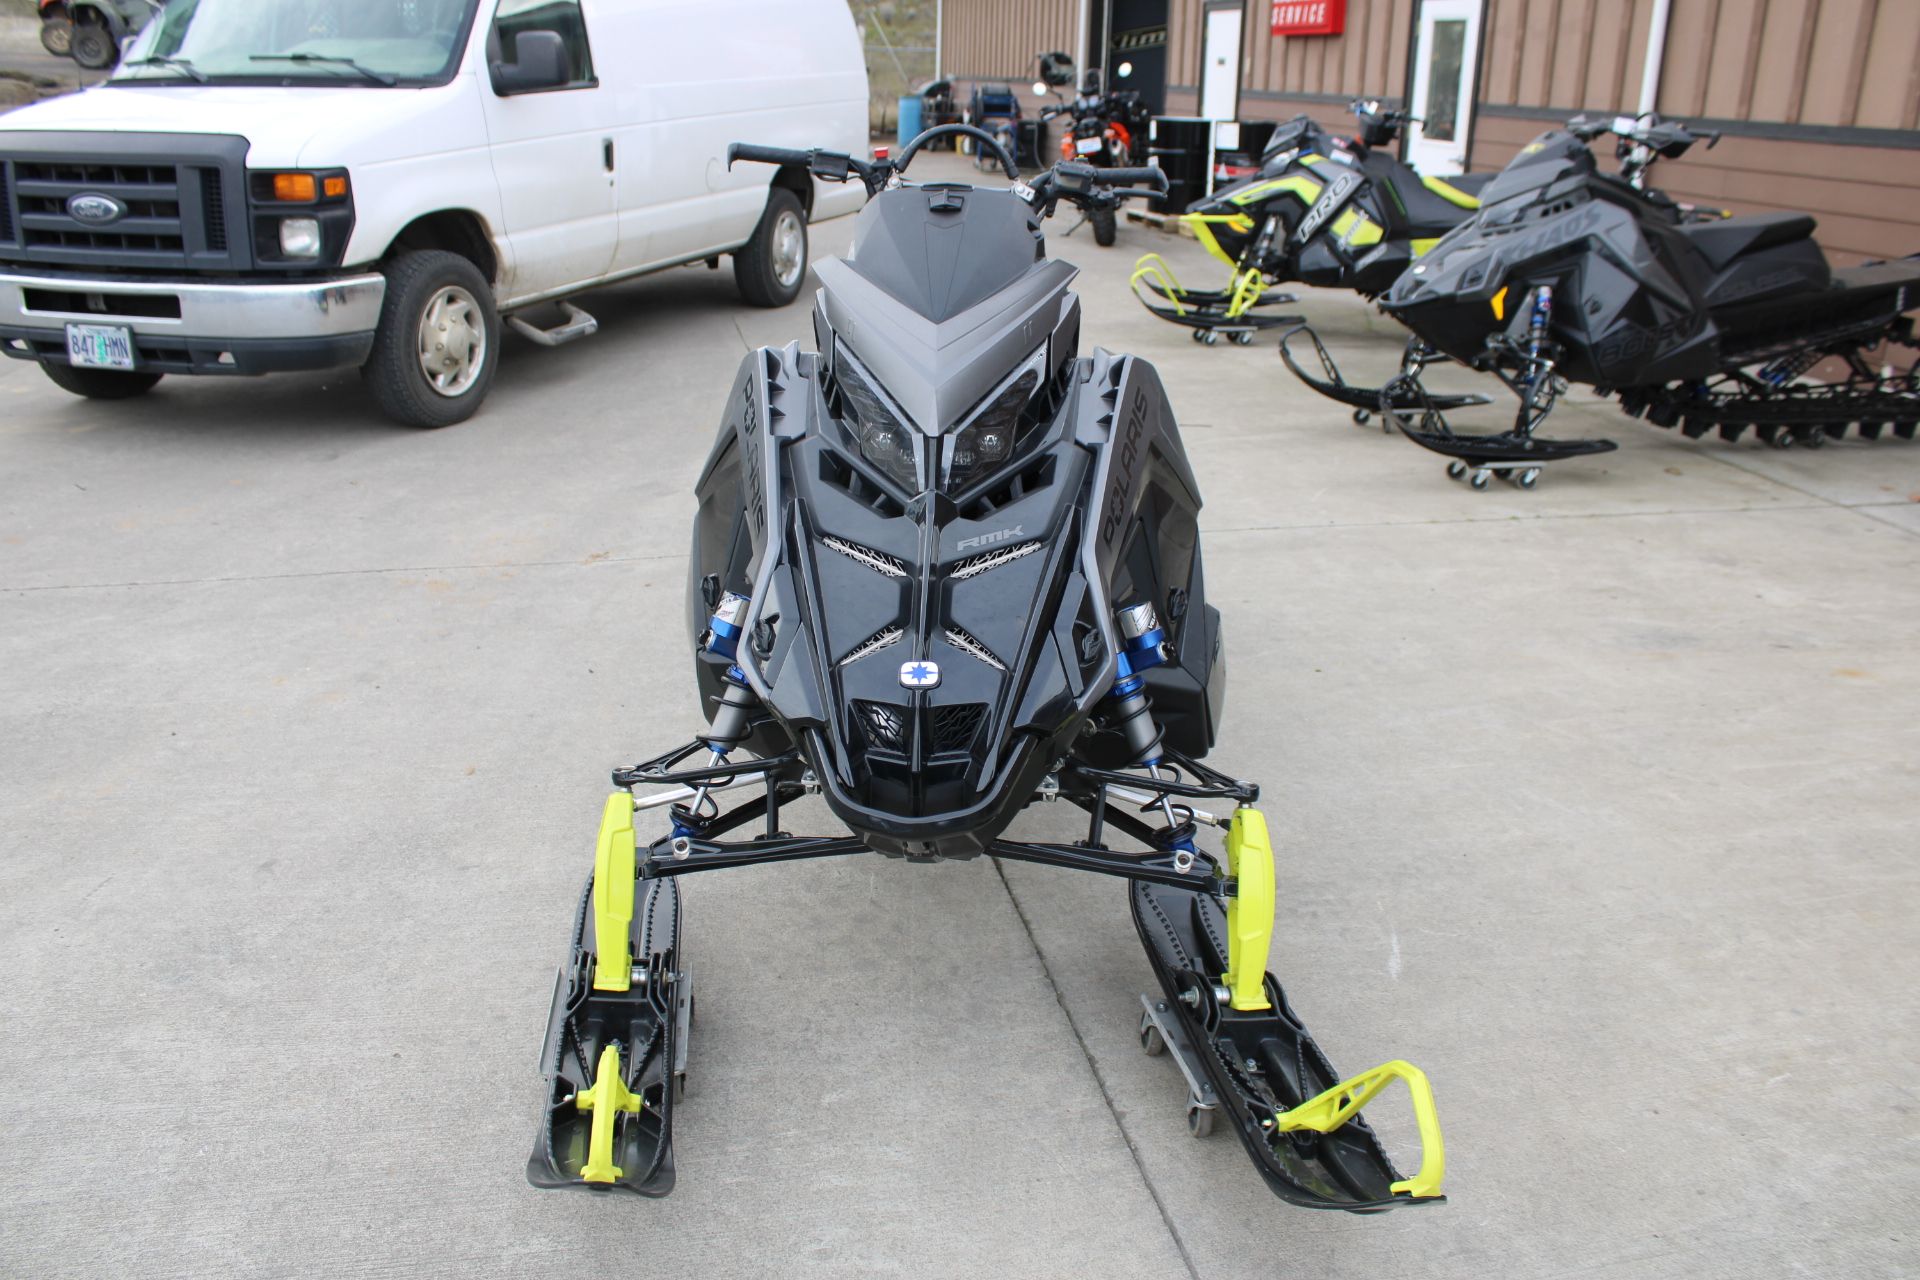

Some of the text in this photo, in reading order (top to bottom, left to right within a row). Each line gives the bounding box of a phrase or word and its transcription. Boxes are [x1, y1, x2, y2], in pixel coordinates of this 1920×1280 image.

[1271, 3, 1327, 26] SERVICE
[1297, 172, 1353, 243] PRO
[72, 334, 130, 359] 847 HMN
[1103, 385, 1148, 549] POLARIS
[957, 525, 1024, 552] RMK
